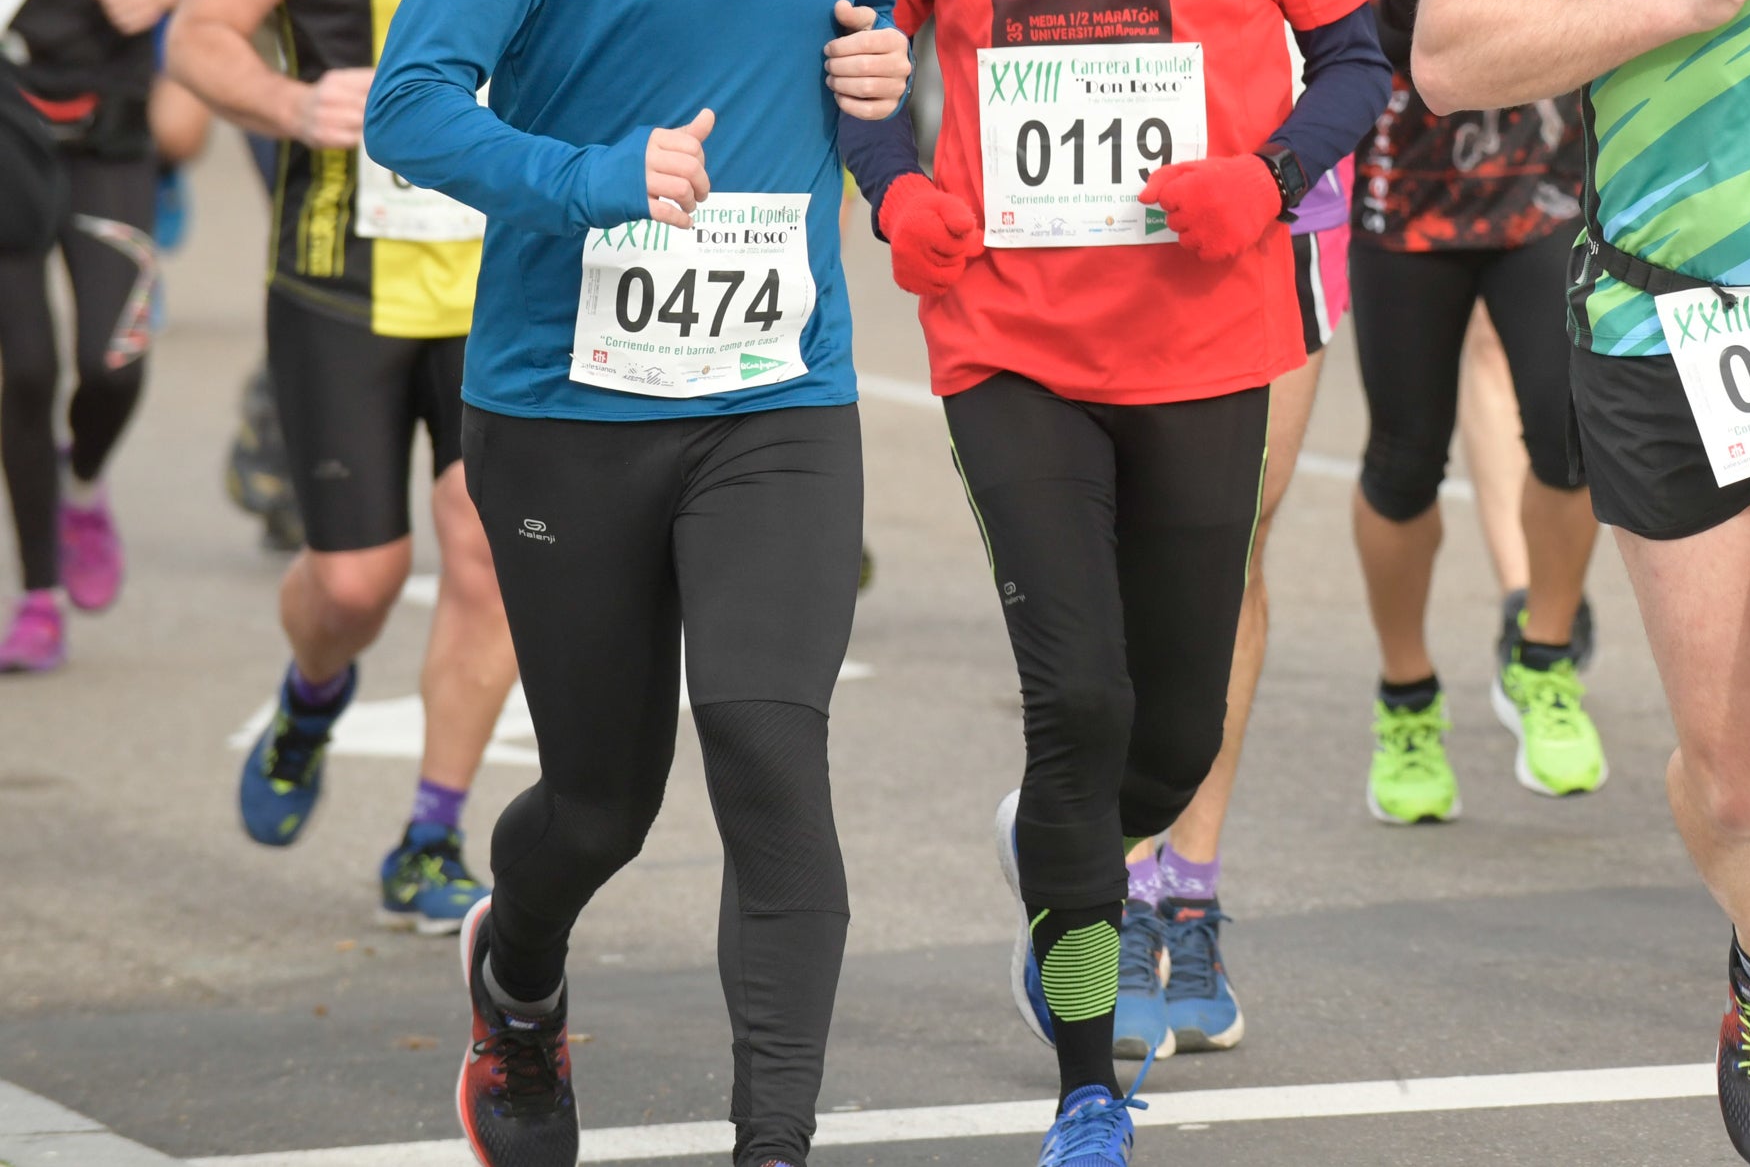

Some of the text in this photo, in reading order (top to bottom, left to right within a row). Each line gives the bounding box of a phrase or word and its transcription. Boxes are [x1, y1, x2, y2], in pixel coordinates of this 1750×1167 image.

[1028, 6, 1160, 28] MEDIA 1/2 MARATÓN
[988, 59, 1063, 107] XXIII
[1071, 58, 1130, 76] Carrera
[1136, 56, 1193, 77] Popular
[1016, 117, 1173, 187] 0119
[1119, 192, 1139, 202] com
[693, 209, 745, 224] arrera
[751, 206, 801, 227] Popular
[615, 266, 783, 337] 0474
[658, 345, 671, 354] en
[674, 346, 684, 356] el
[719, 341, 742, 352] como
[744, 339, 756, 348] en
[518, 528, 556, 544] Kalenji
